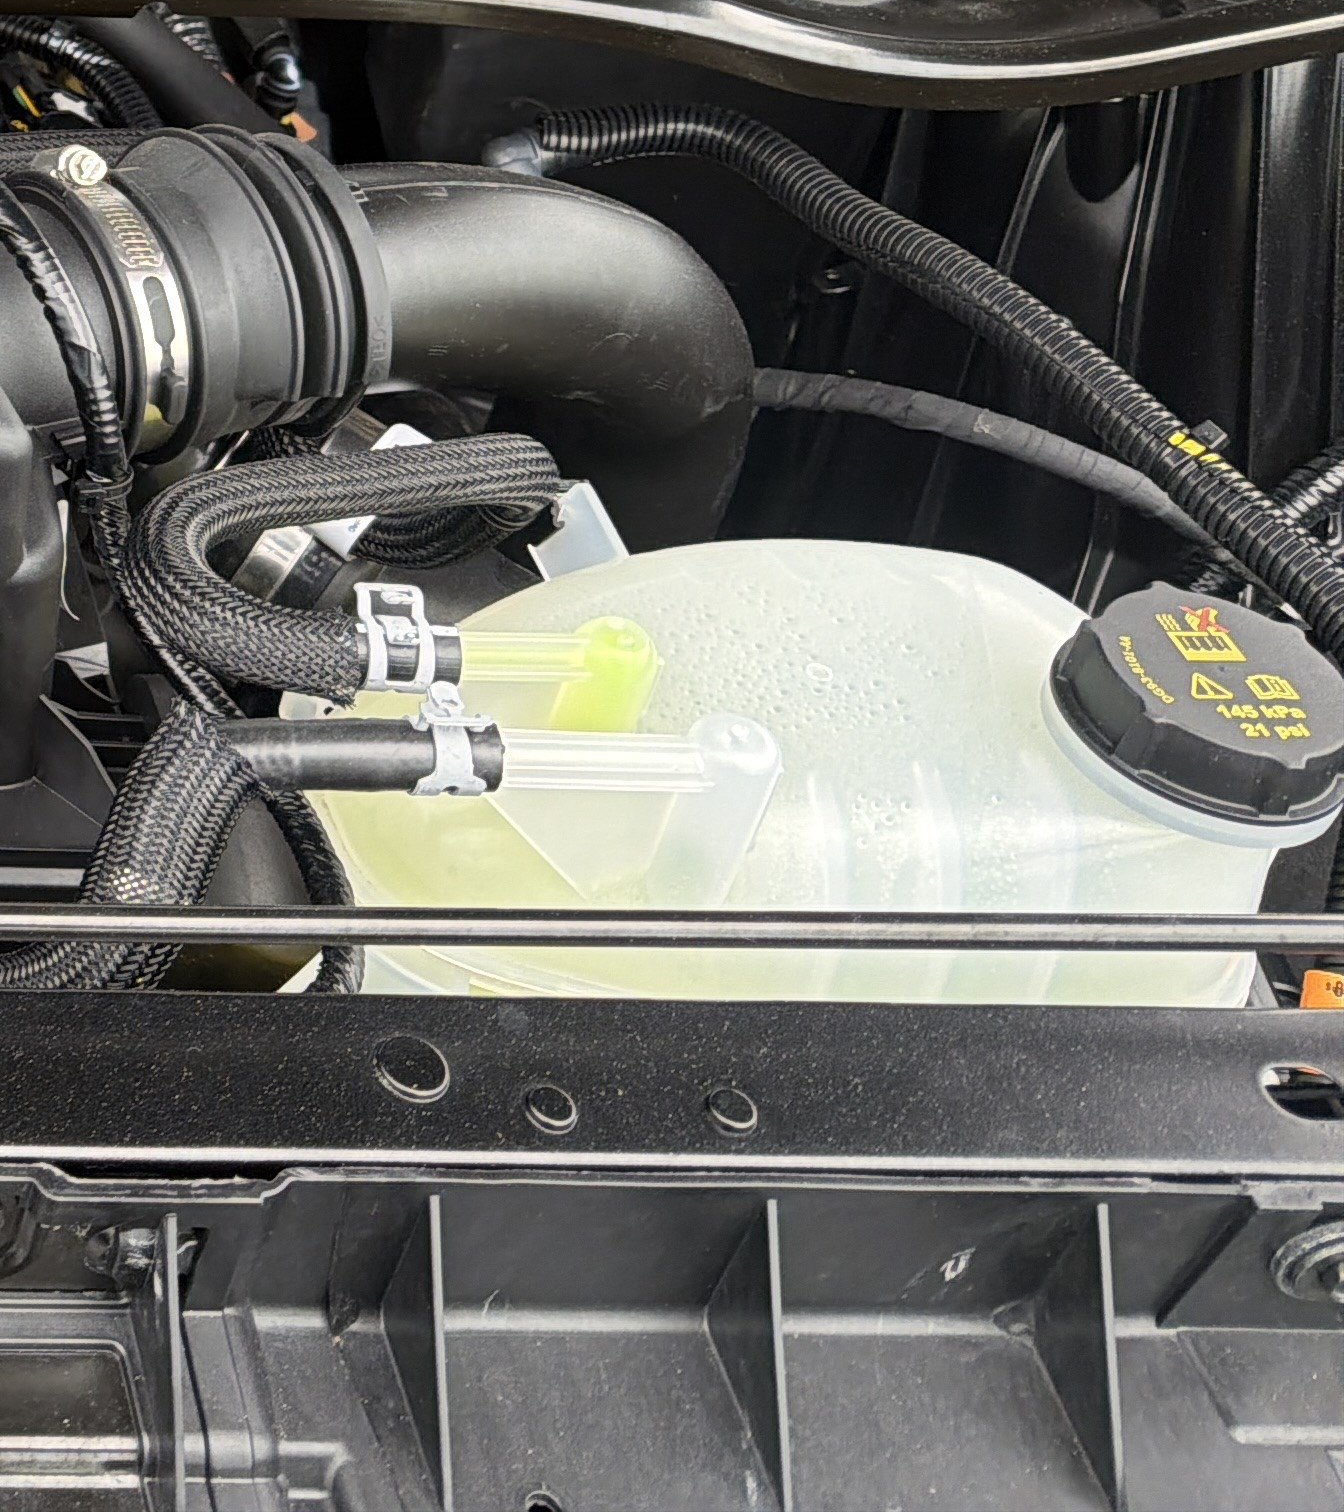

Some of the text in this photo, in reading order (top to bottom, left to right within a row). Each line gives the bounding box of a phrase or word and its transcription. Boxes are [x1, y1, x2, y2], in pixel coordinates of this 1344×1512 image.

[1215, 704, 1308, 719] 145 kPa
[1239, 722, 1312, 740] 21 psi
